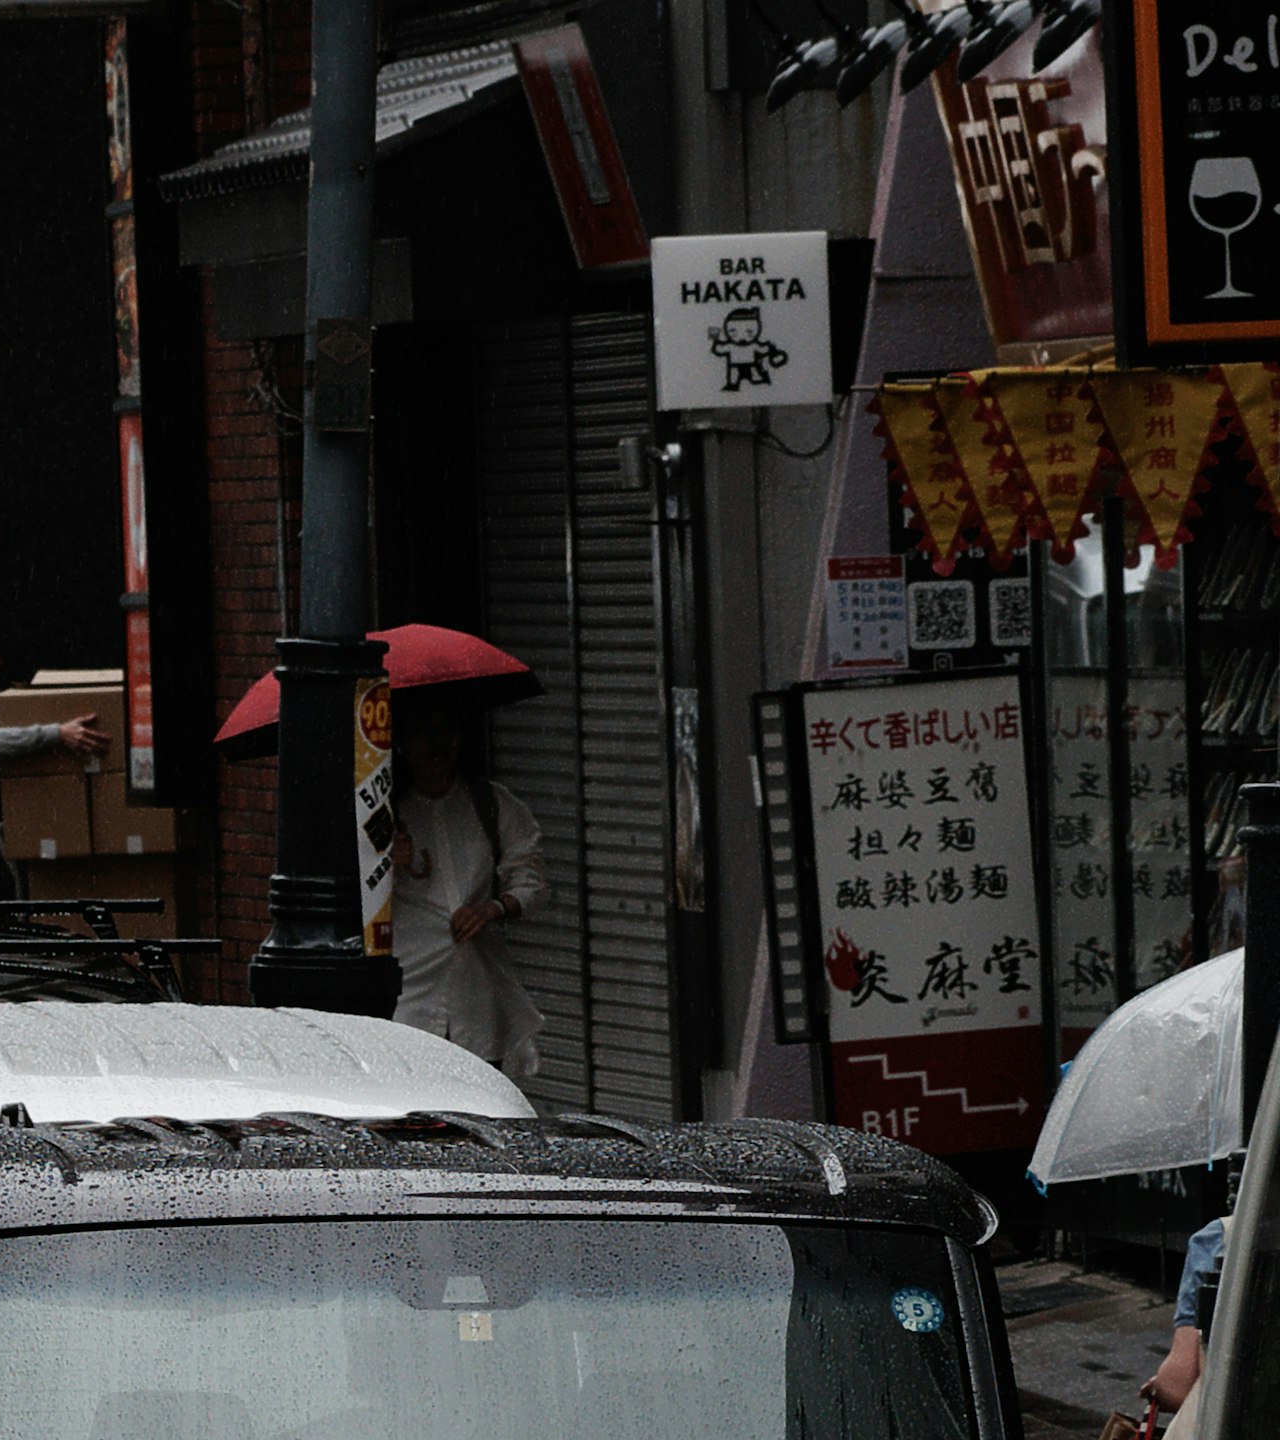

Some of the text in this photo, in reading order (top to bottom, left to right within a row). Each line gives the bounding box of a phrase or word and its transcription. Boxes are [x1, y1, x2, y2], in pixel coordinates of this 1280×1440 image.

[719, 257, 765, 275] BAR
[681, 278, 806, 304] HAKATA
[810, 702, 1019, 755] 辛くて香ばしい店
[831, 762, 1000, 811] 麻婆豆腐
[848, 816, 976, 861] 担々麺
[836, 863, 1010, 910] 酸辣湯麺
[850, 936, 1038, 1008] 炎麻堂
[862, 1107, 920, 1138] B1F
[912, 1303, 925, 1317] 5
